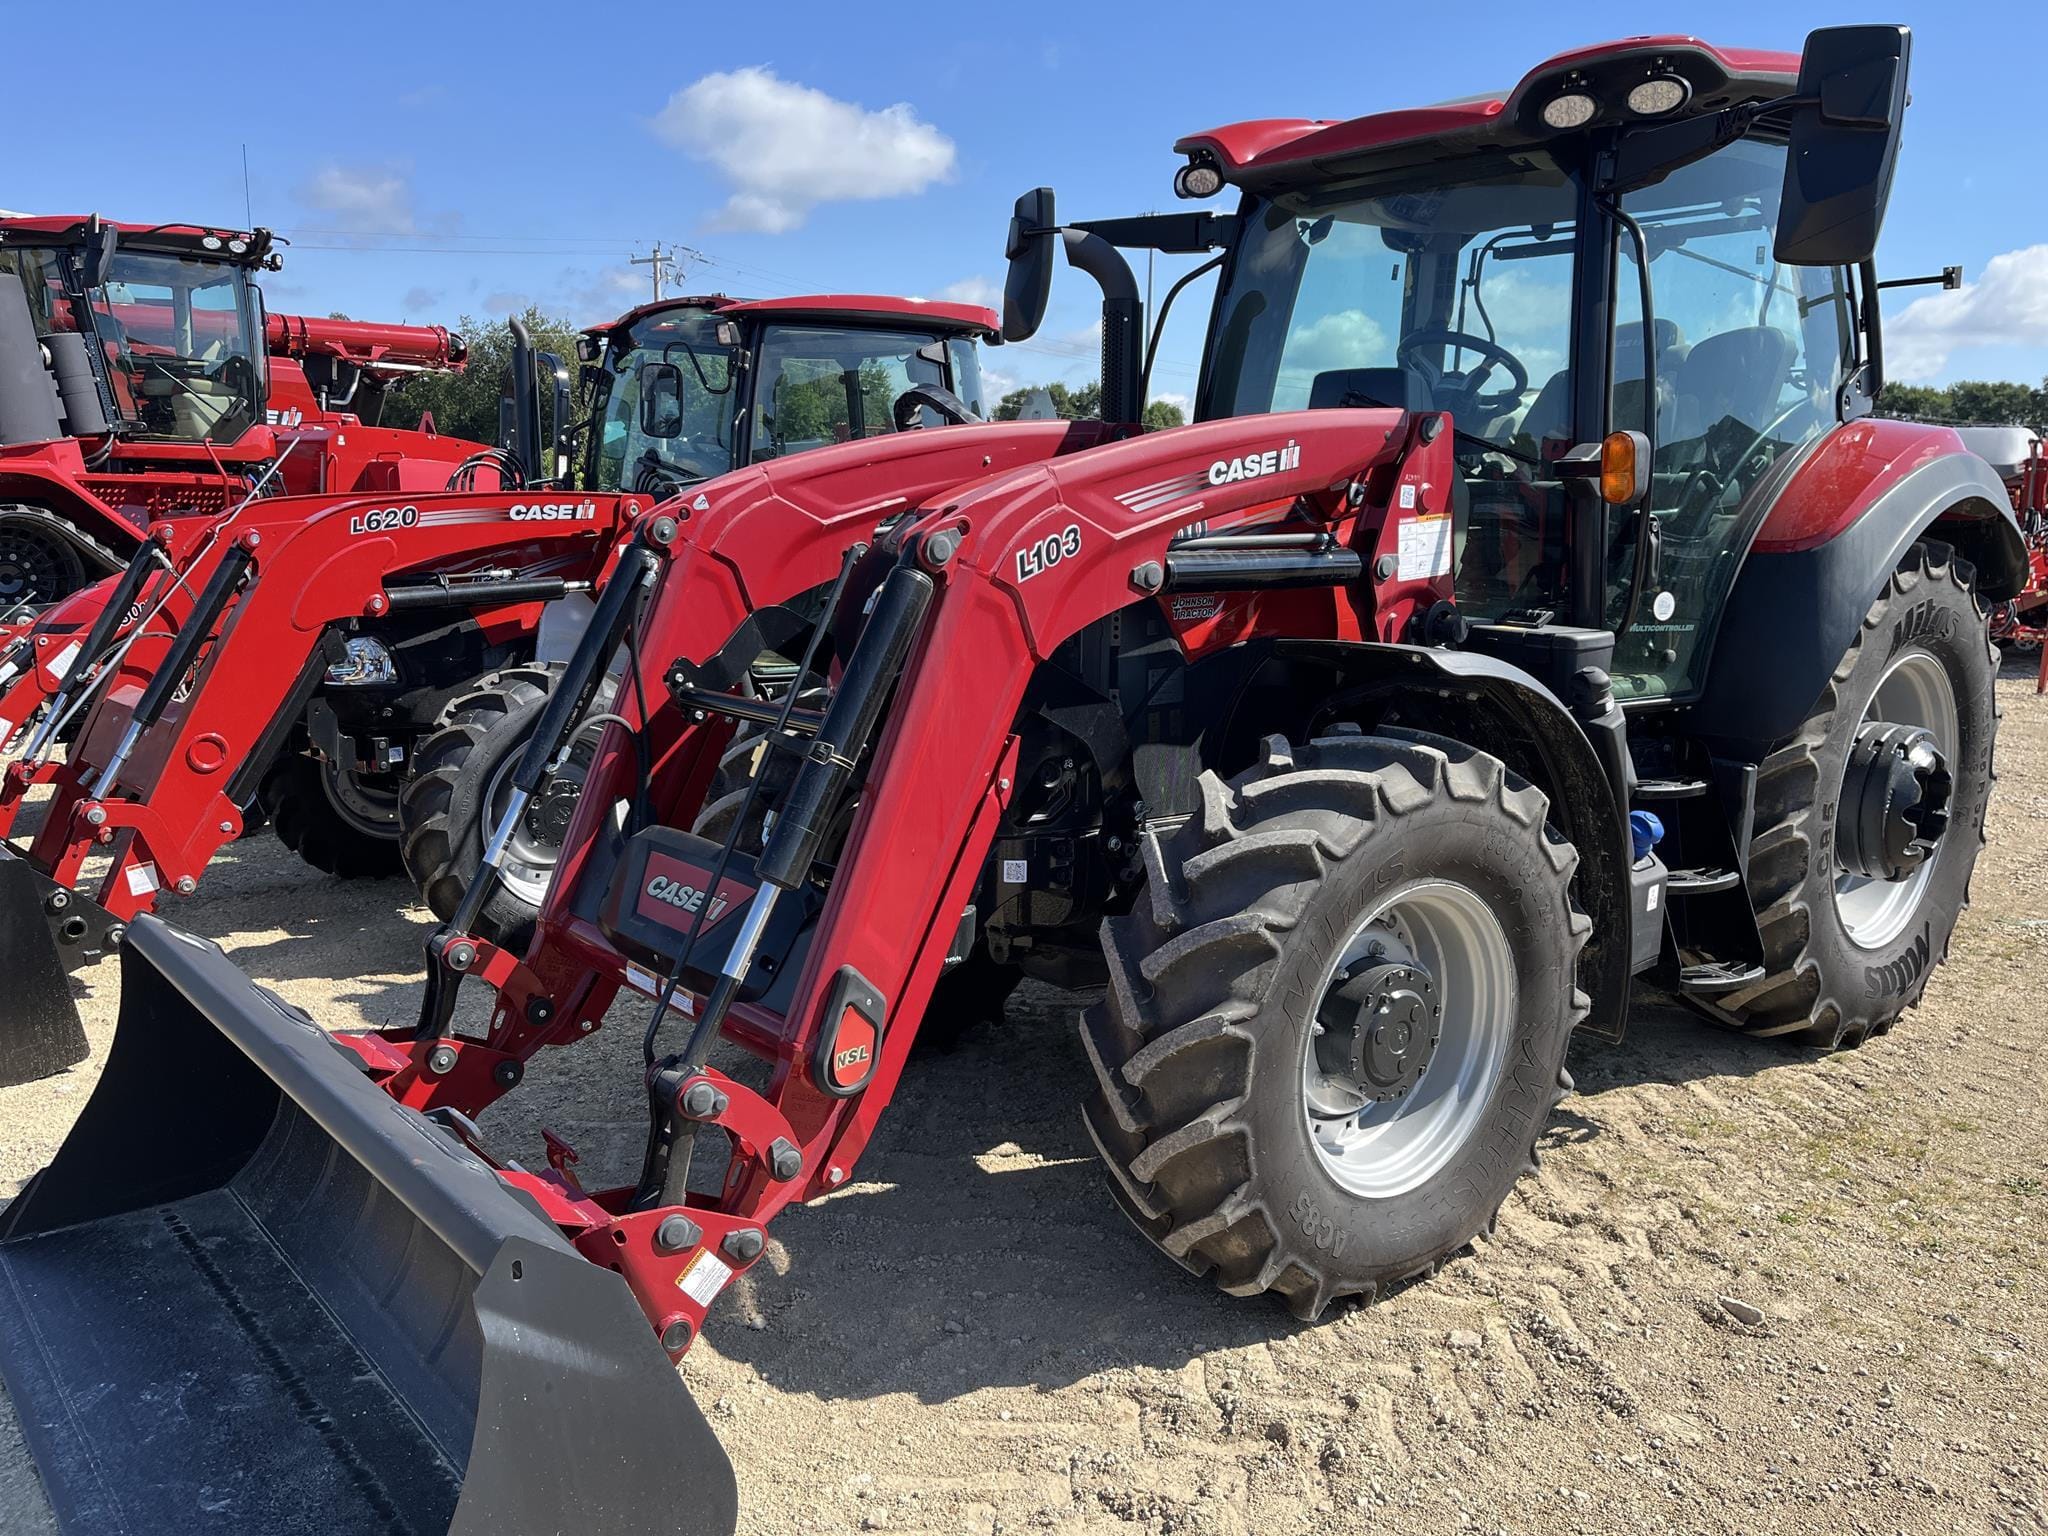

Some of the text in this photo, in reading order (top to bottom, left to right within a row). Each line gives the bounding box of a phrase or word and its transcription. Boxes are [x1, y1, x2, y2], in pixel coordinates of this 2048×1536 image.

[1208, 450, 1277, 486] CASE
[350, 505, 419, 534] L620
[509, 504, 574, 521] CASE
[1016, 524, 1081, 584] L103
[1171, 595, 1215, 608] JOHNSON
[1173, 607, 1214, 620] TRACTOR
[1629, 622, 1695, 633] MULTICONTROLLER
[646, 875, 706, 913] CASE
[836, 1044, 869, 1071] NSL
[681, 1247, 707, 1279] WARNING
